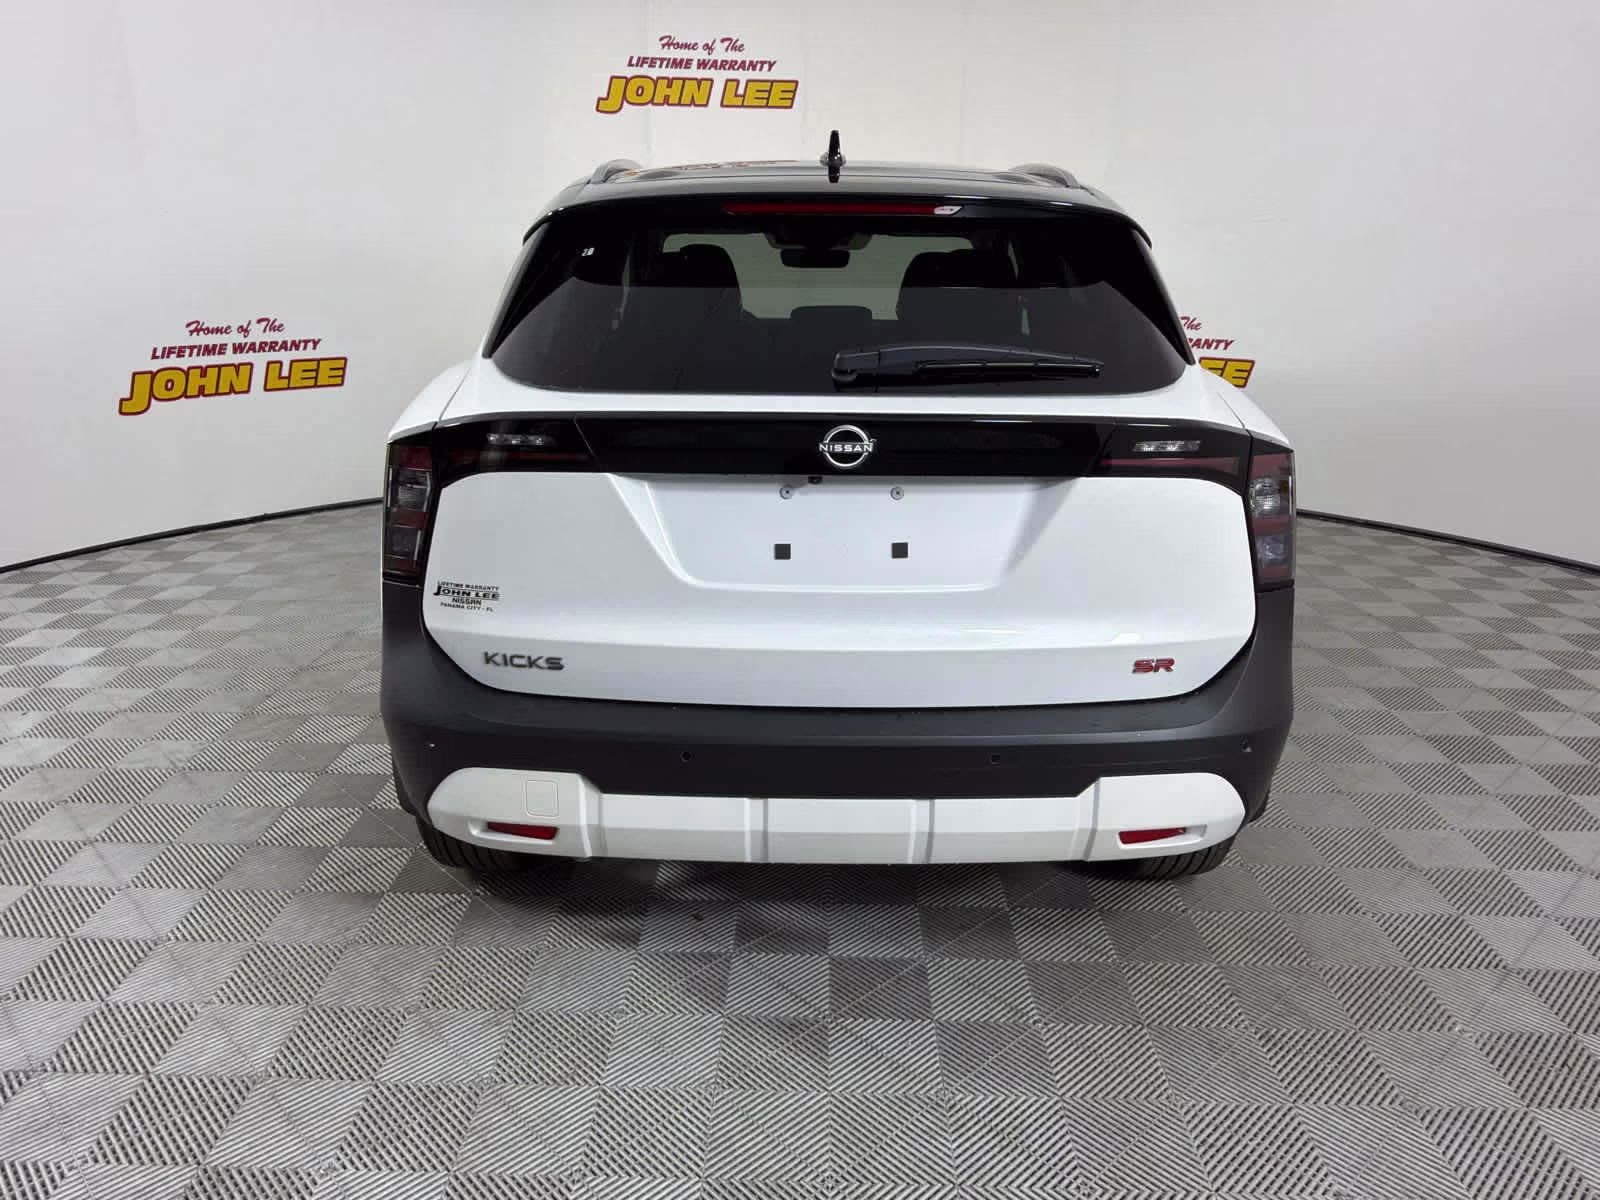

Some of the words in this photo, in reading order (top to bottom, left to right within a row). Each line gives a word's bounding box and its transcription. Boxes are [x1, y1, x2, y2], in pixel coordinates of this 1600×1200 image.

[658, 35, 699, 51] Home
[702, 39, 716, 55] of
[720, 37, 745, 53] The
[627, 56, 693, 70] LIFETIME
[696, 58, 777, 72] WARRANTY
[596, 75, 713, 114] JOHN
[720, 78, 799, 109] LEE
[185, 320, 232, 337] Home
[236, 320, 251, 338] of
[256, 317, 285, 333] The
[1180, 315, 1202, 331] The
[151, 342, 228, 360] LIFETIME
[232, 338, 322, 355] WARRANTY
[119, 362, 253, 415] JOHN
[263, 357, 347, 392] LEE
[819, 442, 873, 453] NISSAN
[433, 585, 472, 597] JOHN
[474, 591, 499, 600] LEE
[465, 583, 499, 591] WARRANTY
[452, 597, 482, 606] NISSAN
[483, 651, 564, 670] KICKS
[1132, 658, 1175, 674] SR
